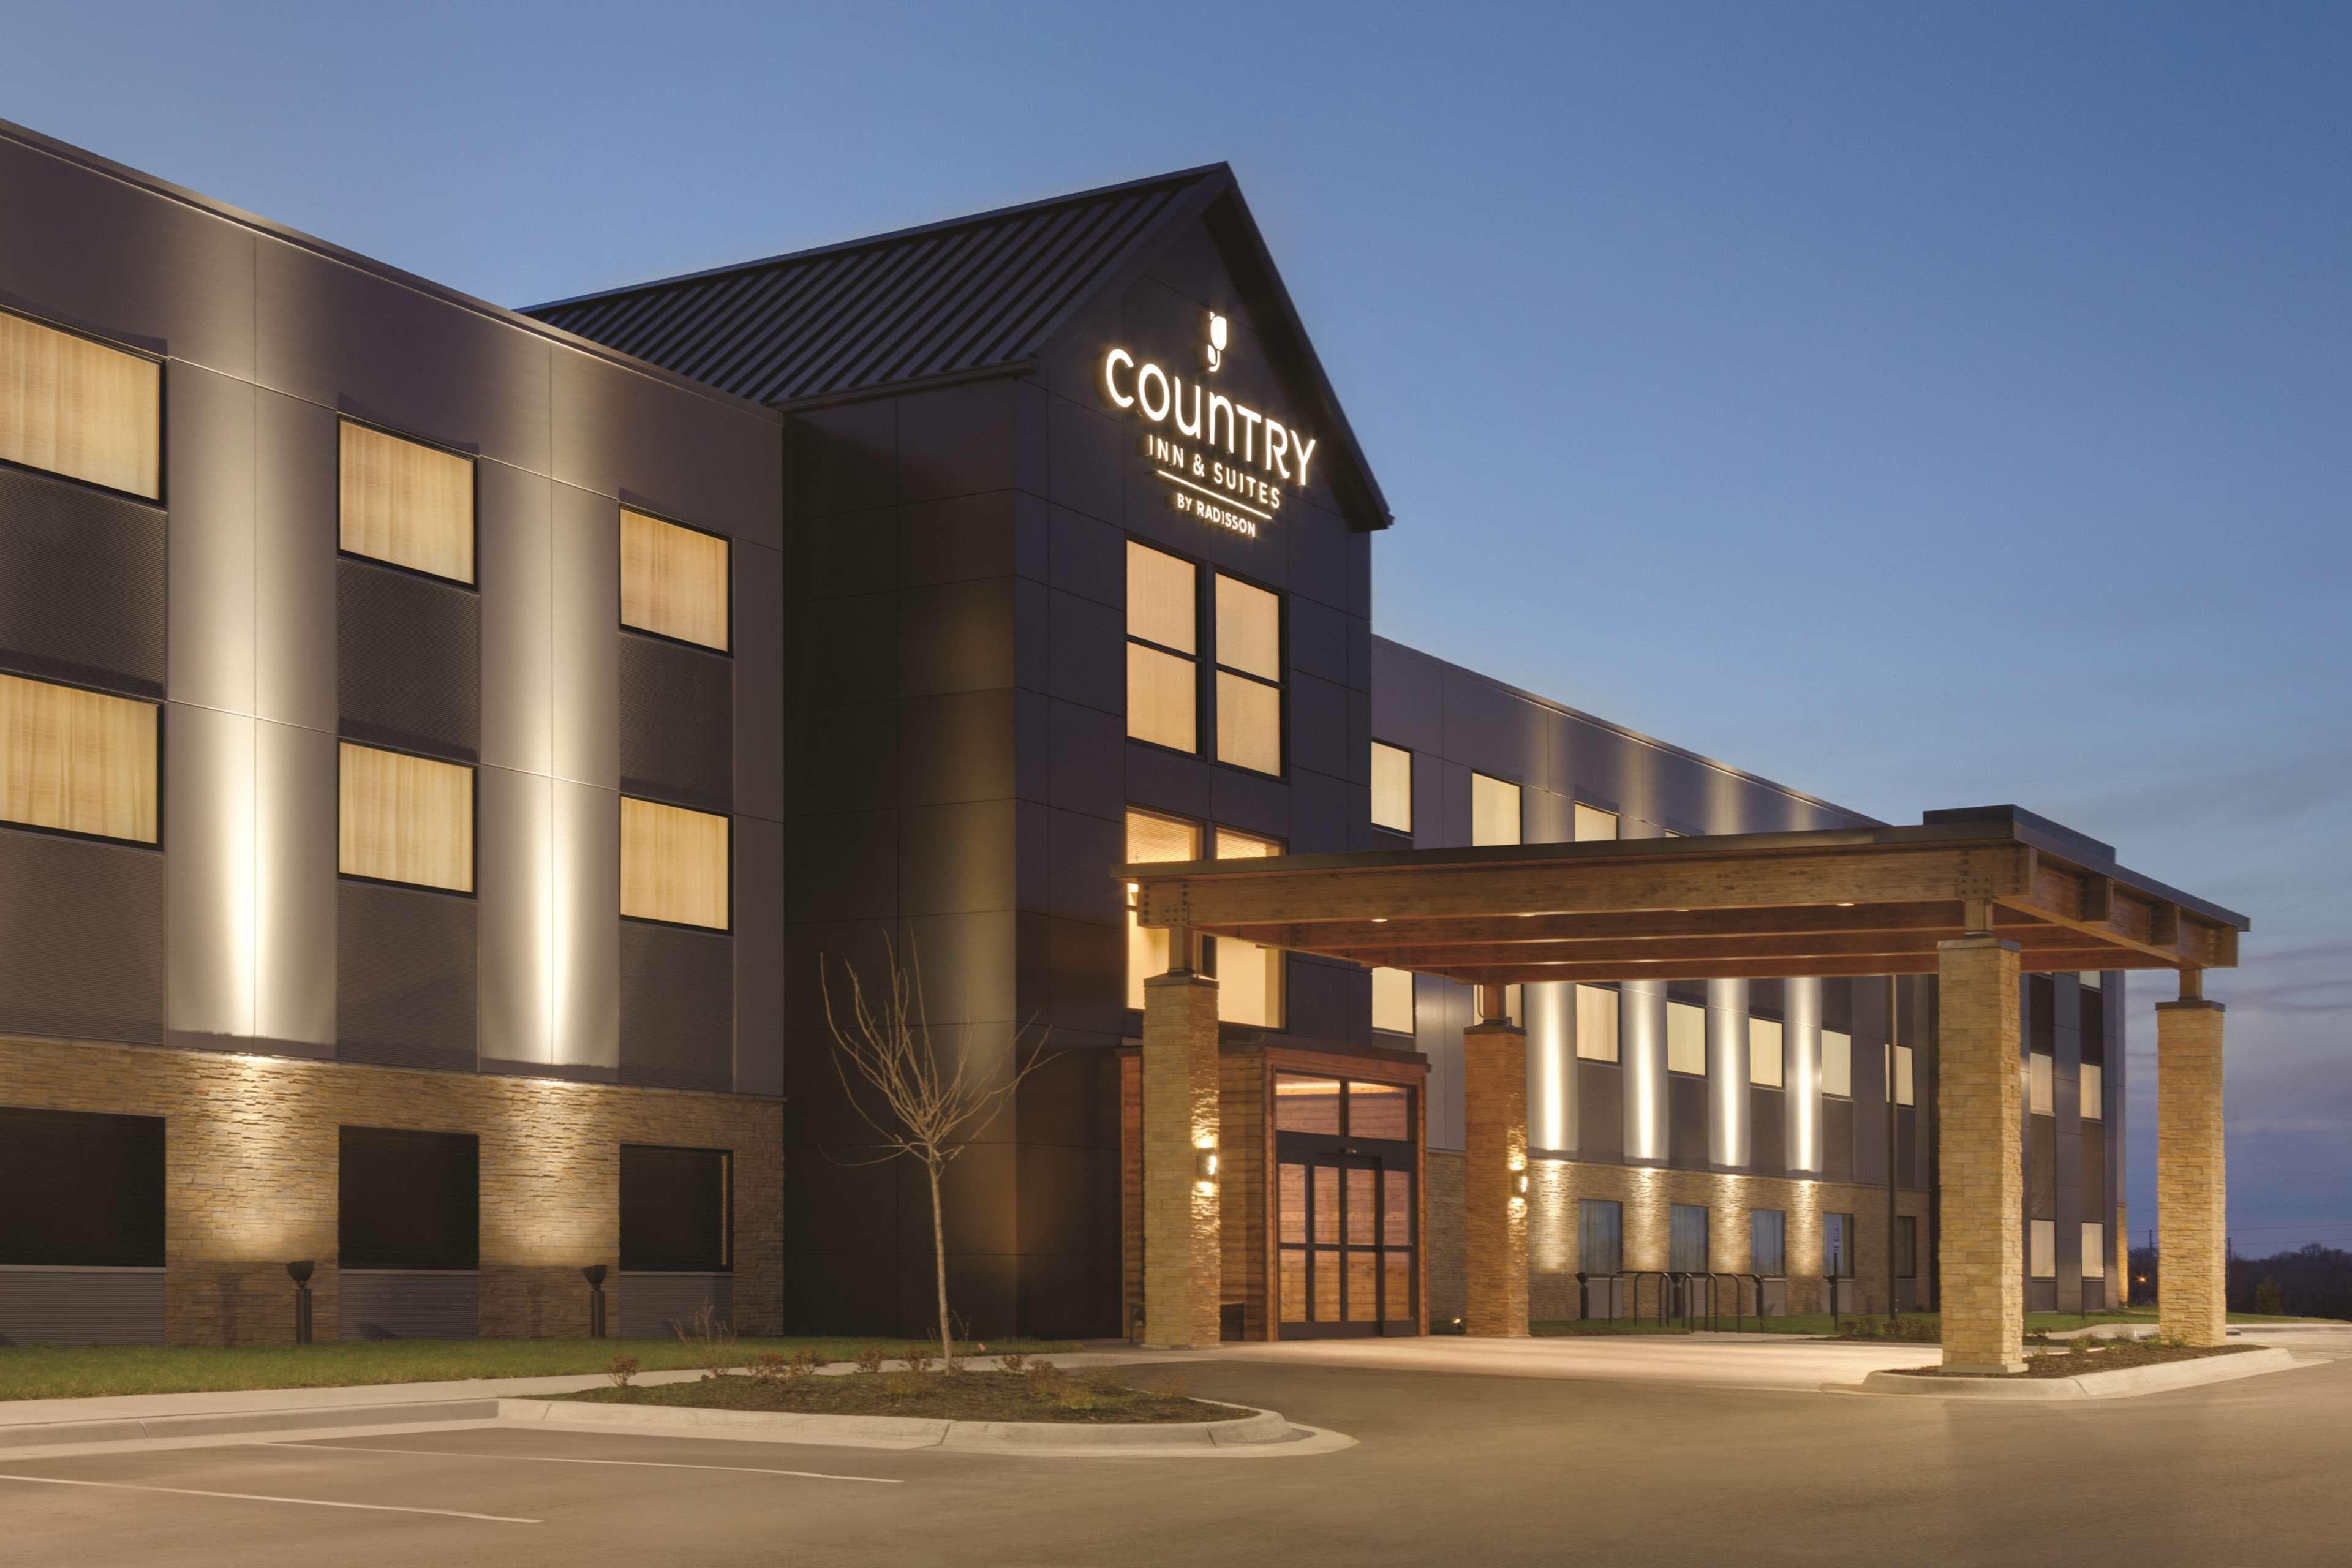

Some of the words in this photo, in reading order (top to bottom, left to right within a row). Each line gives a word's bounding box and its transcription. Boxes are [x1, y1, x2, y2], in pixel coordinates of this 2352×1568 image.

[1148, 434, 1185, 469] INN
[1193, 453, 1205, 477] &
[1213, 462, 1281, 509] SUITES
[1177, 492, 1193, 511] BY
[1196, 500, 1256, 538] RADISSON
